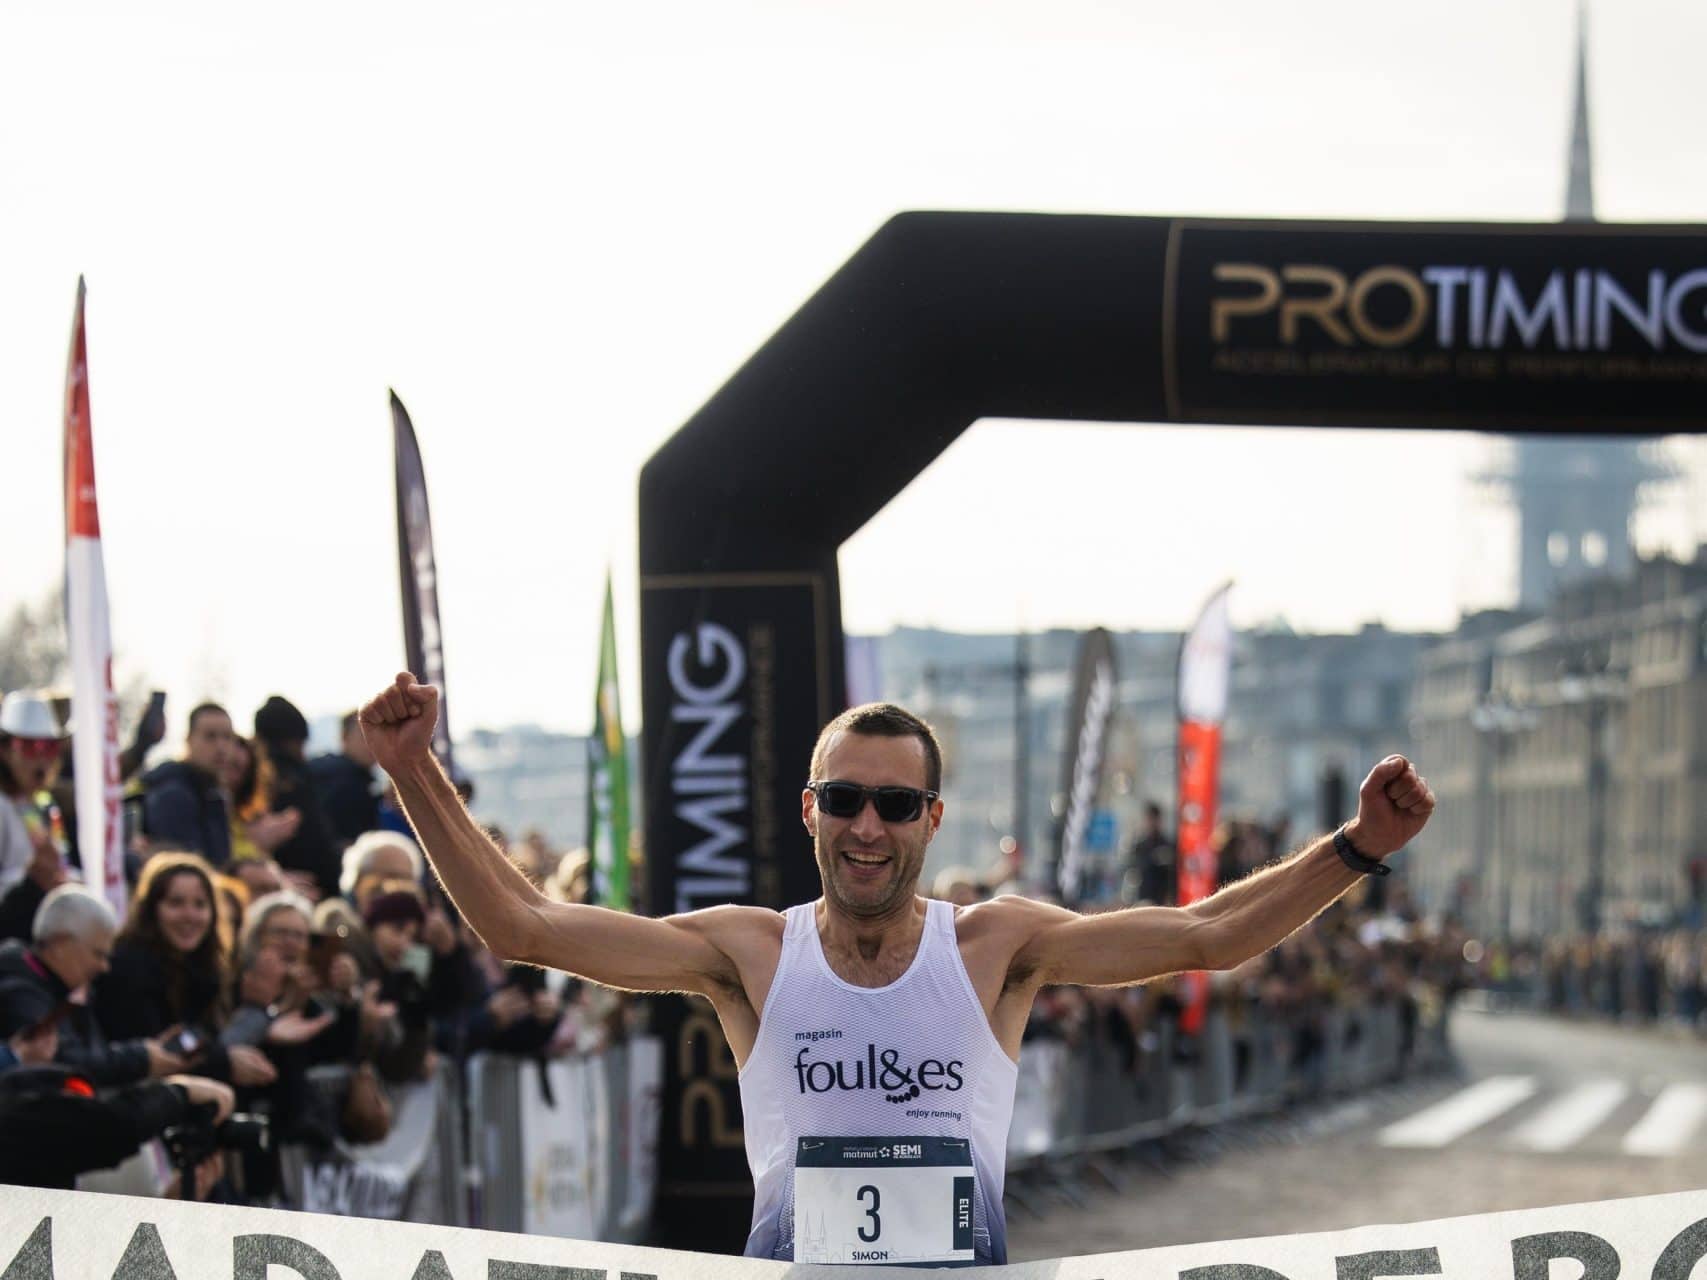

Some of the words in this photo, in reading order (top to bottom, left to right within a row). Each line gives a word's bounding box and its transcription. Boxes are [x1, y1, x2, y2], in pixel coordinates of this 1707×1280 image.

[794, 1028, 843, 1041] magasin
[905, 1108, 929, 1119] enjoy
[930, 1109, 962, 1121] running
[843, 1151, 877, 1159] matmut
[892, 1144, 921, 1155] SEMI
[856, 1185, 881, 1243] 3
[959, 1198, 969, 1228] ELITE
[851, 1251, 888, 1260] SIMON
